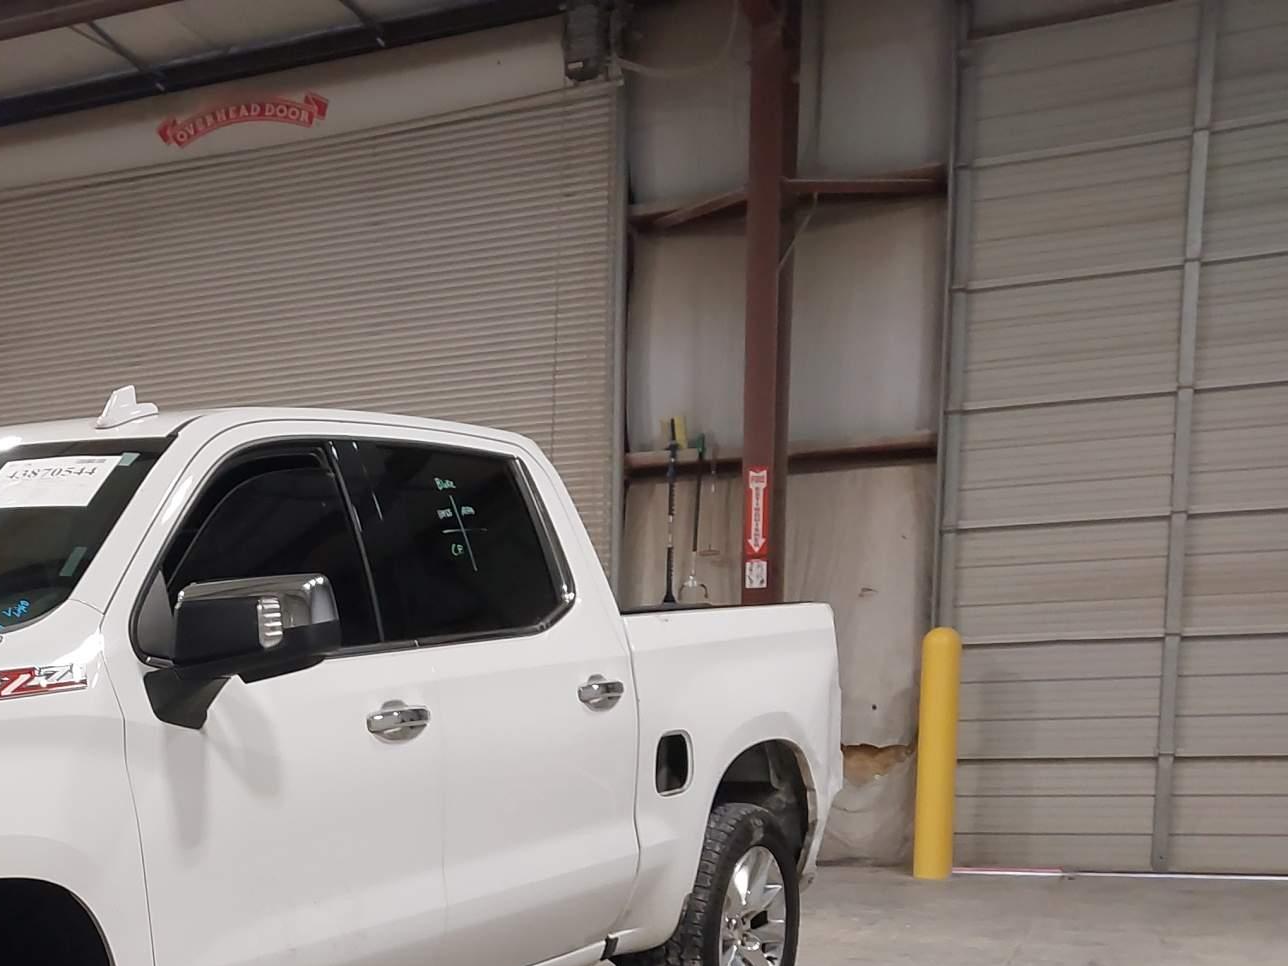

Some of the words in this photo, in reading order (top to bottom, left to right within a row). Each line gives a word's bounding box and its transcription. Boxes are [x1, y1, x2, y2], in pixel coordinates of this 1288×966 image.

[176, 103, 260, 142] OVERHEAD
[264, 103, 310, 123] DOOR
[8, 466, 98, 481] 43870544
